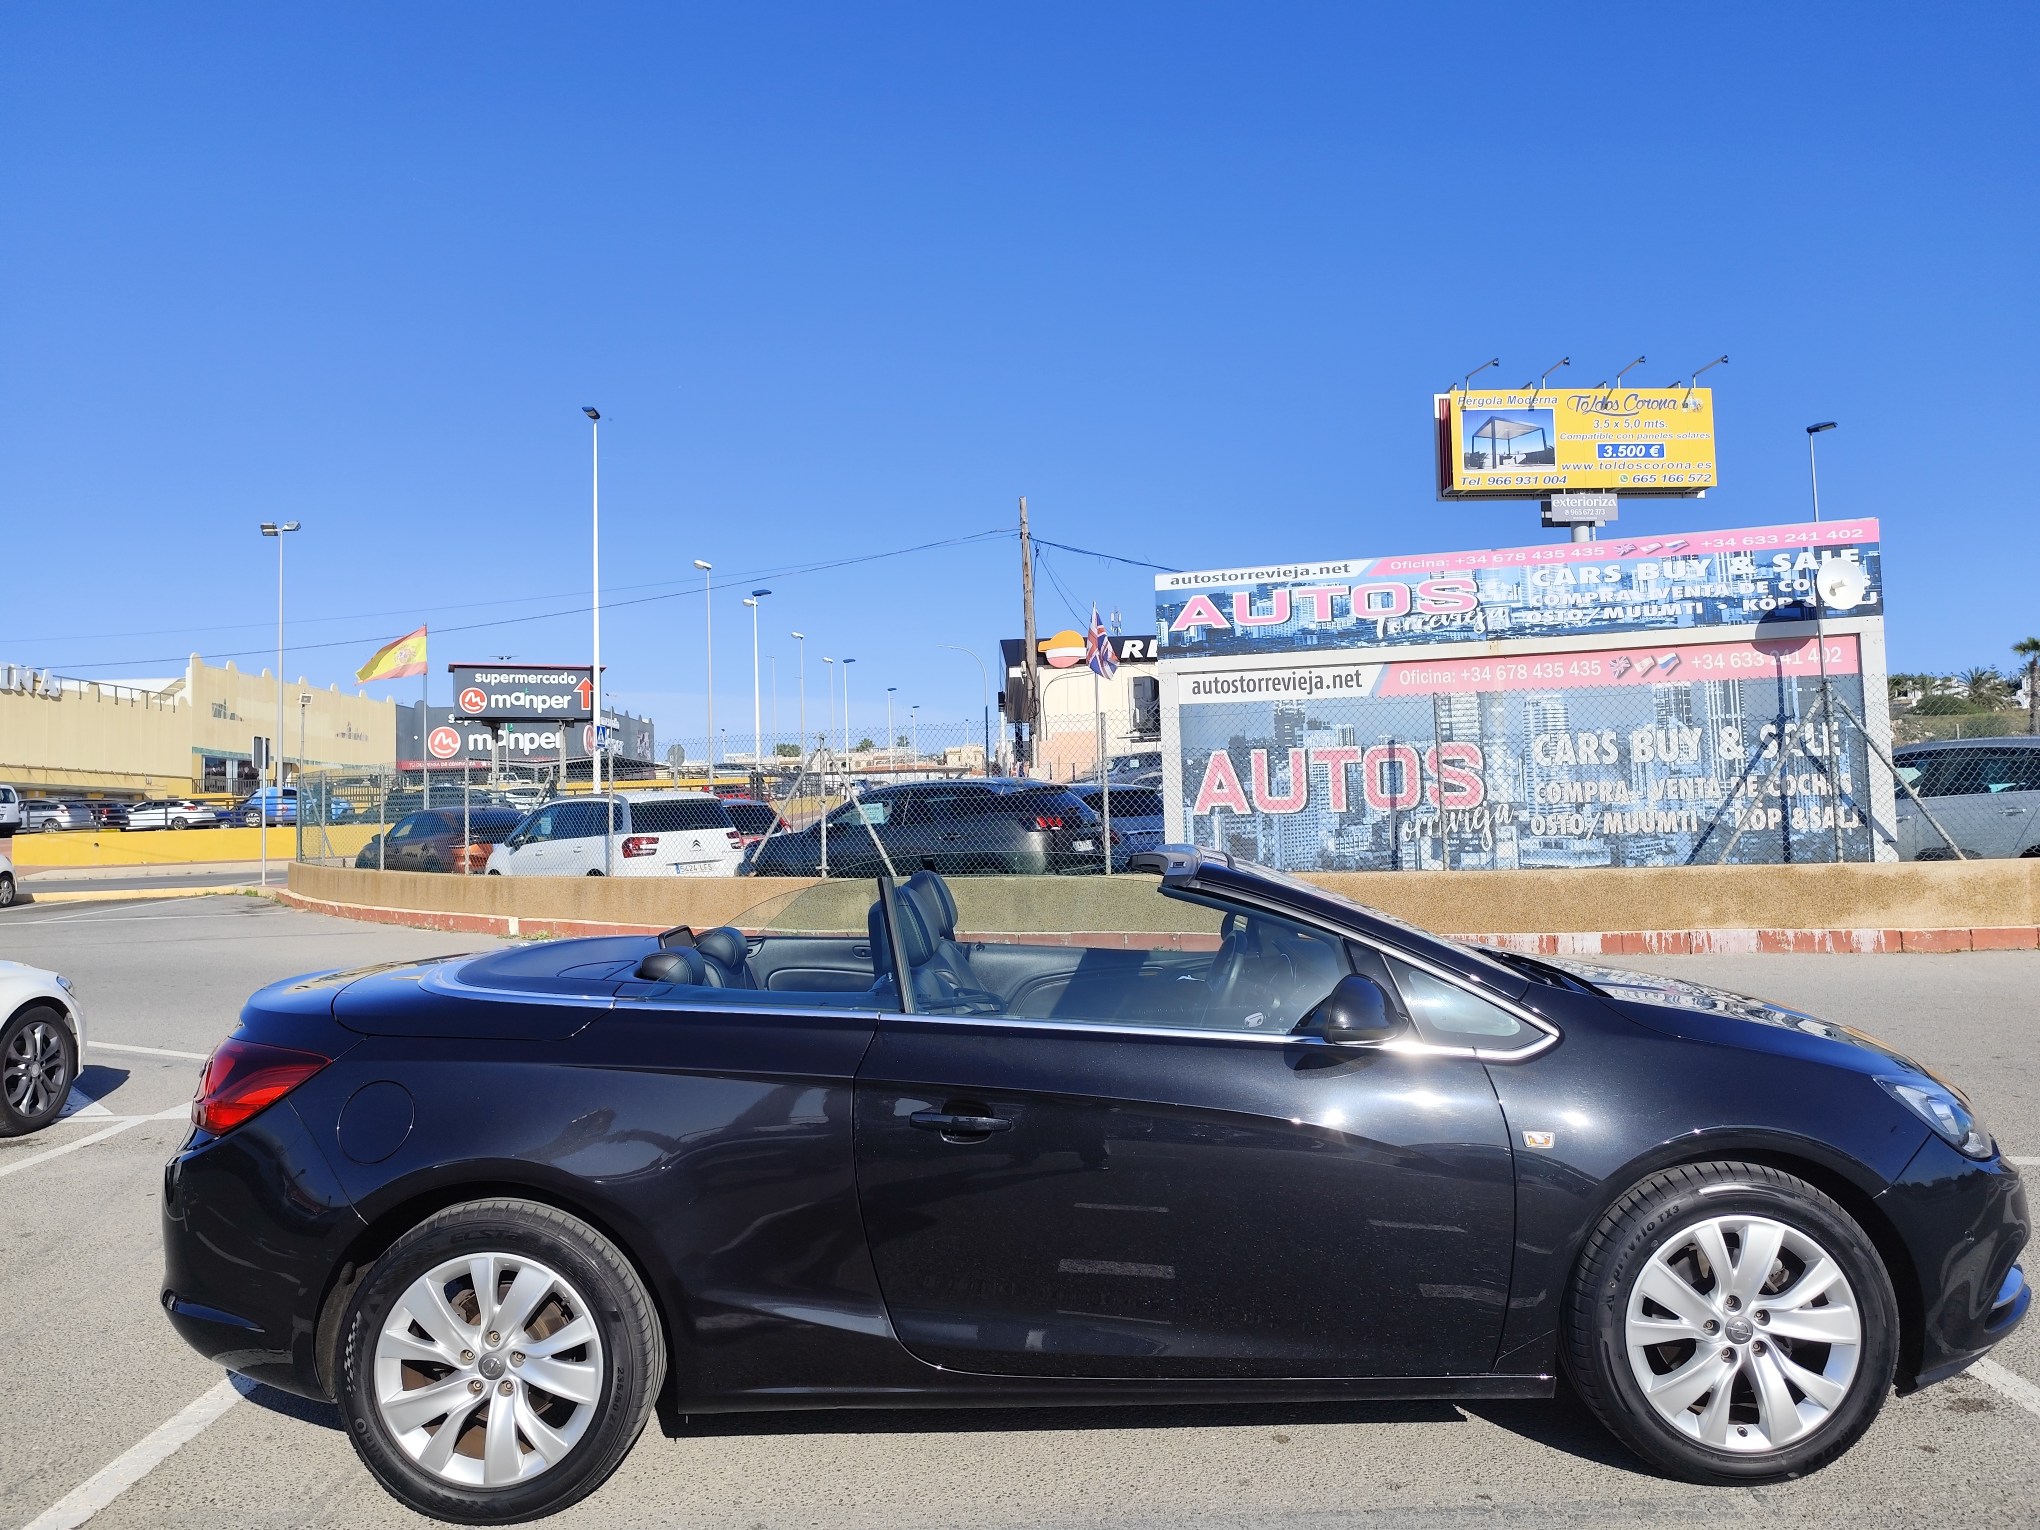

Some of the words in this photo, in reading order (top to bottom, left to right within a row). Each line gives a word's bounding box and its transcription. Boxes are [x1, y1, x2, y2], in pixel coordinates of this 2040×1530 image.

[1507, 395, 1558, 405] Moderna
[1567, 394, 1620, 414] Toldos
[1624, 393, 1679, 411] Corona
[1593, 419, 1610, 429] 3,5
[1623, 419, 1641, 429] 5,0
[1644, 420, 1668, 428] mts.
[1559, 433, 1614, 441] Compatible
[1637, 433, 1674, 441] paneles
[1603, 445, 1646, 457] 3.500
[1649, 445, 1661, 457] €
[1561, 461, 1712, 471] www.toldoscorona.es
[1460, 476, 1483, 486] Tel.
[1487, 476, 1511, 486] 966
[1515, 475, 1539, 485] 931
[1543, 475, 1568, 484] 004
[1632, 474, 1657, 483] 665
[1661, 474, 1684, 483] 166
[1688, 473, 1712, 483] 572
[1552, 496, 1617, 507] exterioriza
[1170, 563, 1351, 585] autostorrevieja.net
[1390, 557, 1450, 570] Oficina:
[1454, 555, 1488, 565] +34
[1492, 551, 1527, 563] 678
[1531, 550, 1566, 559] 435
[1570, 547, 1605, 557] 435
[1701, 537, 1737, 548] +34
[1742, 535, 1779, 545] 633
[1785, 532, 1822, 543] 241
[1826, 528, 1864, 539] 402
[1169, 578, 1479, 631] AUTOS
[1531, 564, 1622, 587] CARS
[1637, 558, 1713, 581] BUY
[1730, 556, 1757, 574] &
[1739, 581, 1769, 594] DE
[475, 672, 577, 686] supermercado
[1191, 669, 1363, 695] autostorrevieja.net
[1399, 668, 1457, 686] Oficina:
[1460, 666, 1492, 682] +34
[1495, 664, 1528, 680] 678
[1532, 661, 1565, 678] 435
[1569, 659, 1602, 676] 435
[1691, 653, 1726, 669] +34
[1730, 652, 1765, 668] 633
[1769, 650, 1804, 665] 241
[491, 691, 572, 713] manper
[1194, 742, 1487, 815] AUTOS
[1533, 732, 1620, 766] CARS
[1633, 727, 1703, 763] BUY
[1718, 725, 1747, 760] &
[1647, 777, 1724, 801] VENTA
[1730, 776, 1759, 798] DE
[1658, 1205, 1680, 1223] TX3
